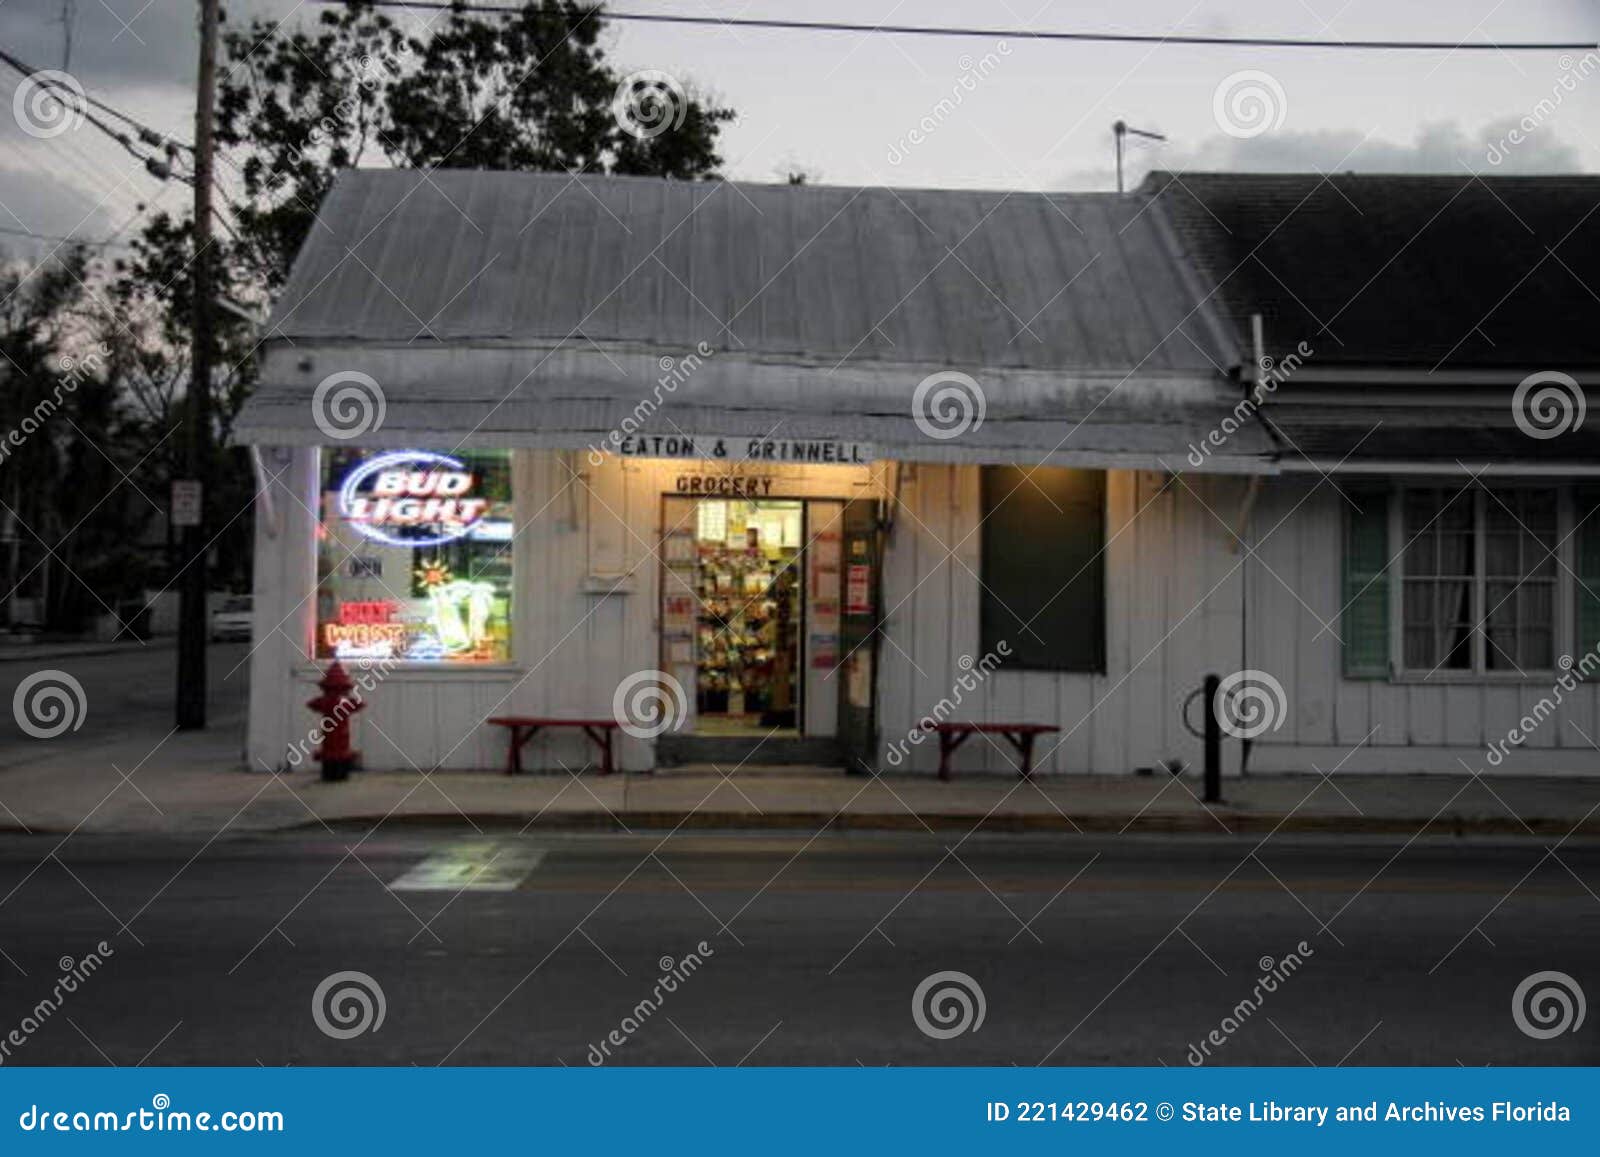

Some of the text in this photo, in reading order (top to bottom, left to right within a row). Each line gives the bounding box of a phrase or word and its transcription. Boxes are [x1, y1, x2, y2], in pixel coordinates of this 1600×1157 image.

[620, 437, 866, 464] EATON & GRINNELL
[373, 470, 474, 497] BUD
[676, 476, 773, 497] GROCERY
[350, 498, 487, 525] LIGHT
